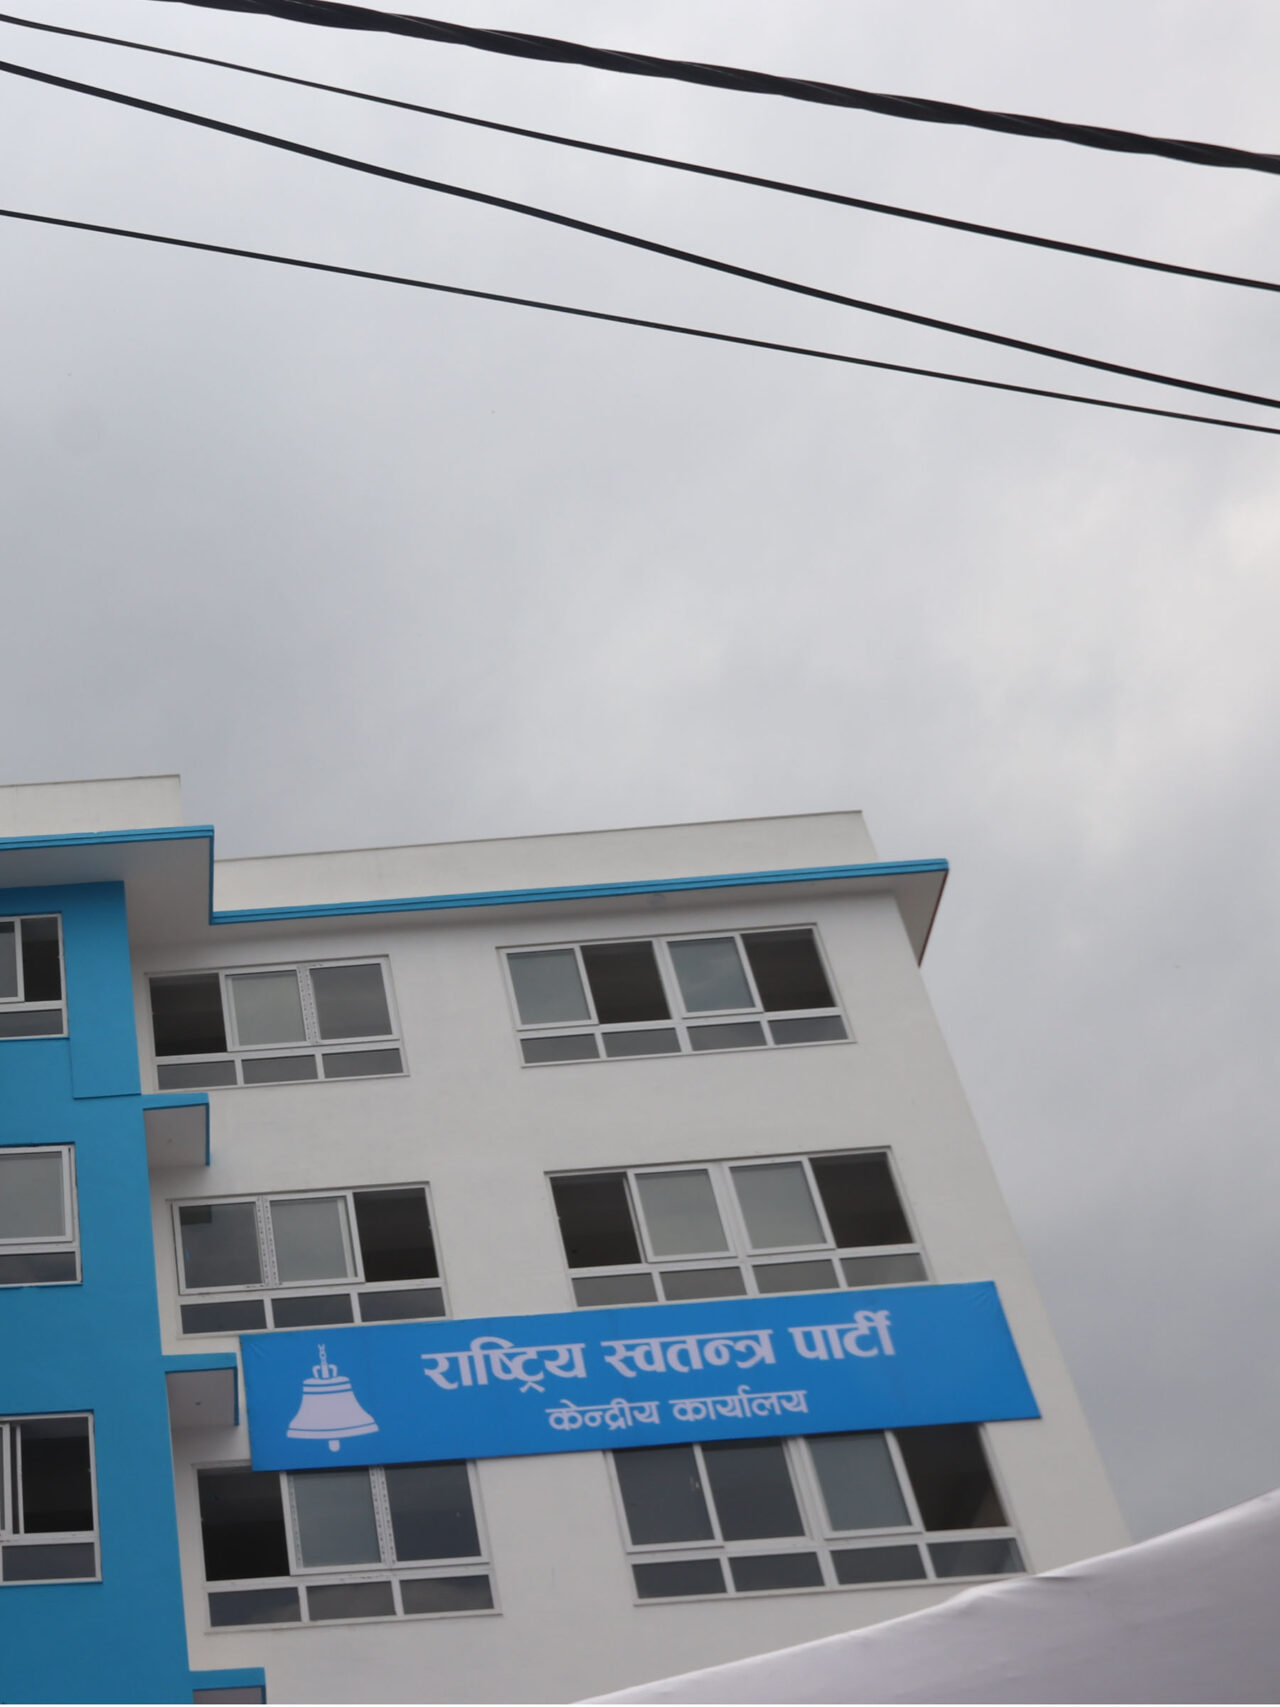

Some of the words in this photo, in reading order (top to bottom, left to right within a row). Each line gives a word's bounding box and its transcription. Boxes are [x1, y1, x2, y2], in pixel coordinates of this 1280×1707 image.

[421, 1336, 587, 1393] राष्ट्रिय
[601, 1329, 775, 1378] स्वतन्त्र
[788, 1311, 895, 1360] पार्टी
[545, 1398, 660, 1431] केन्द्रीय
[669, 1385, 808, 1422] कार्यालय
